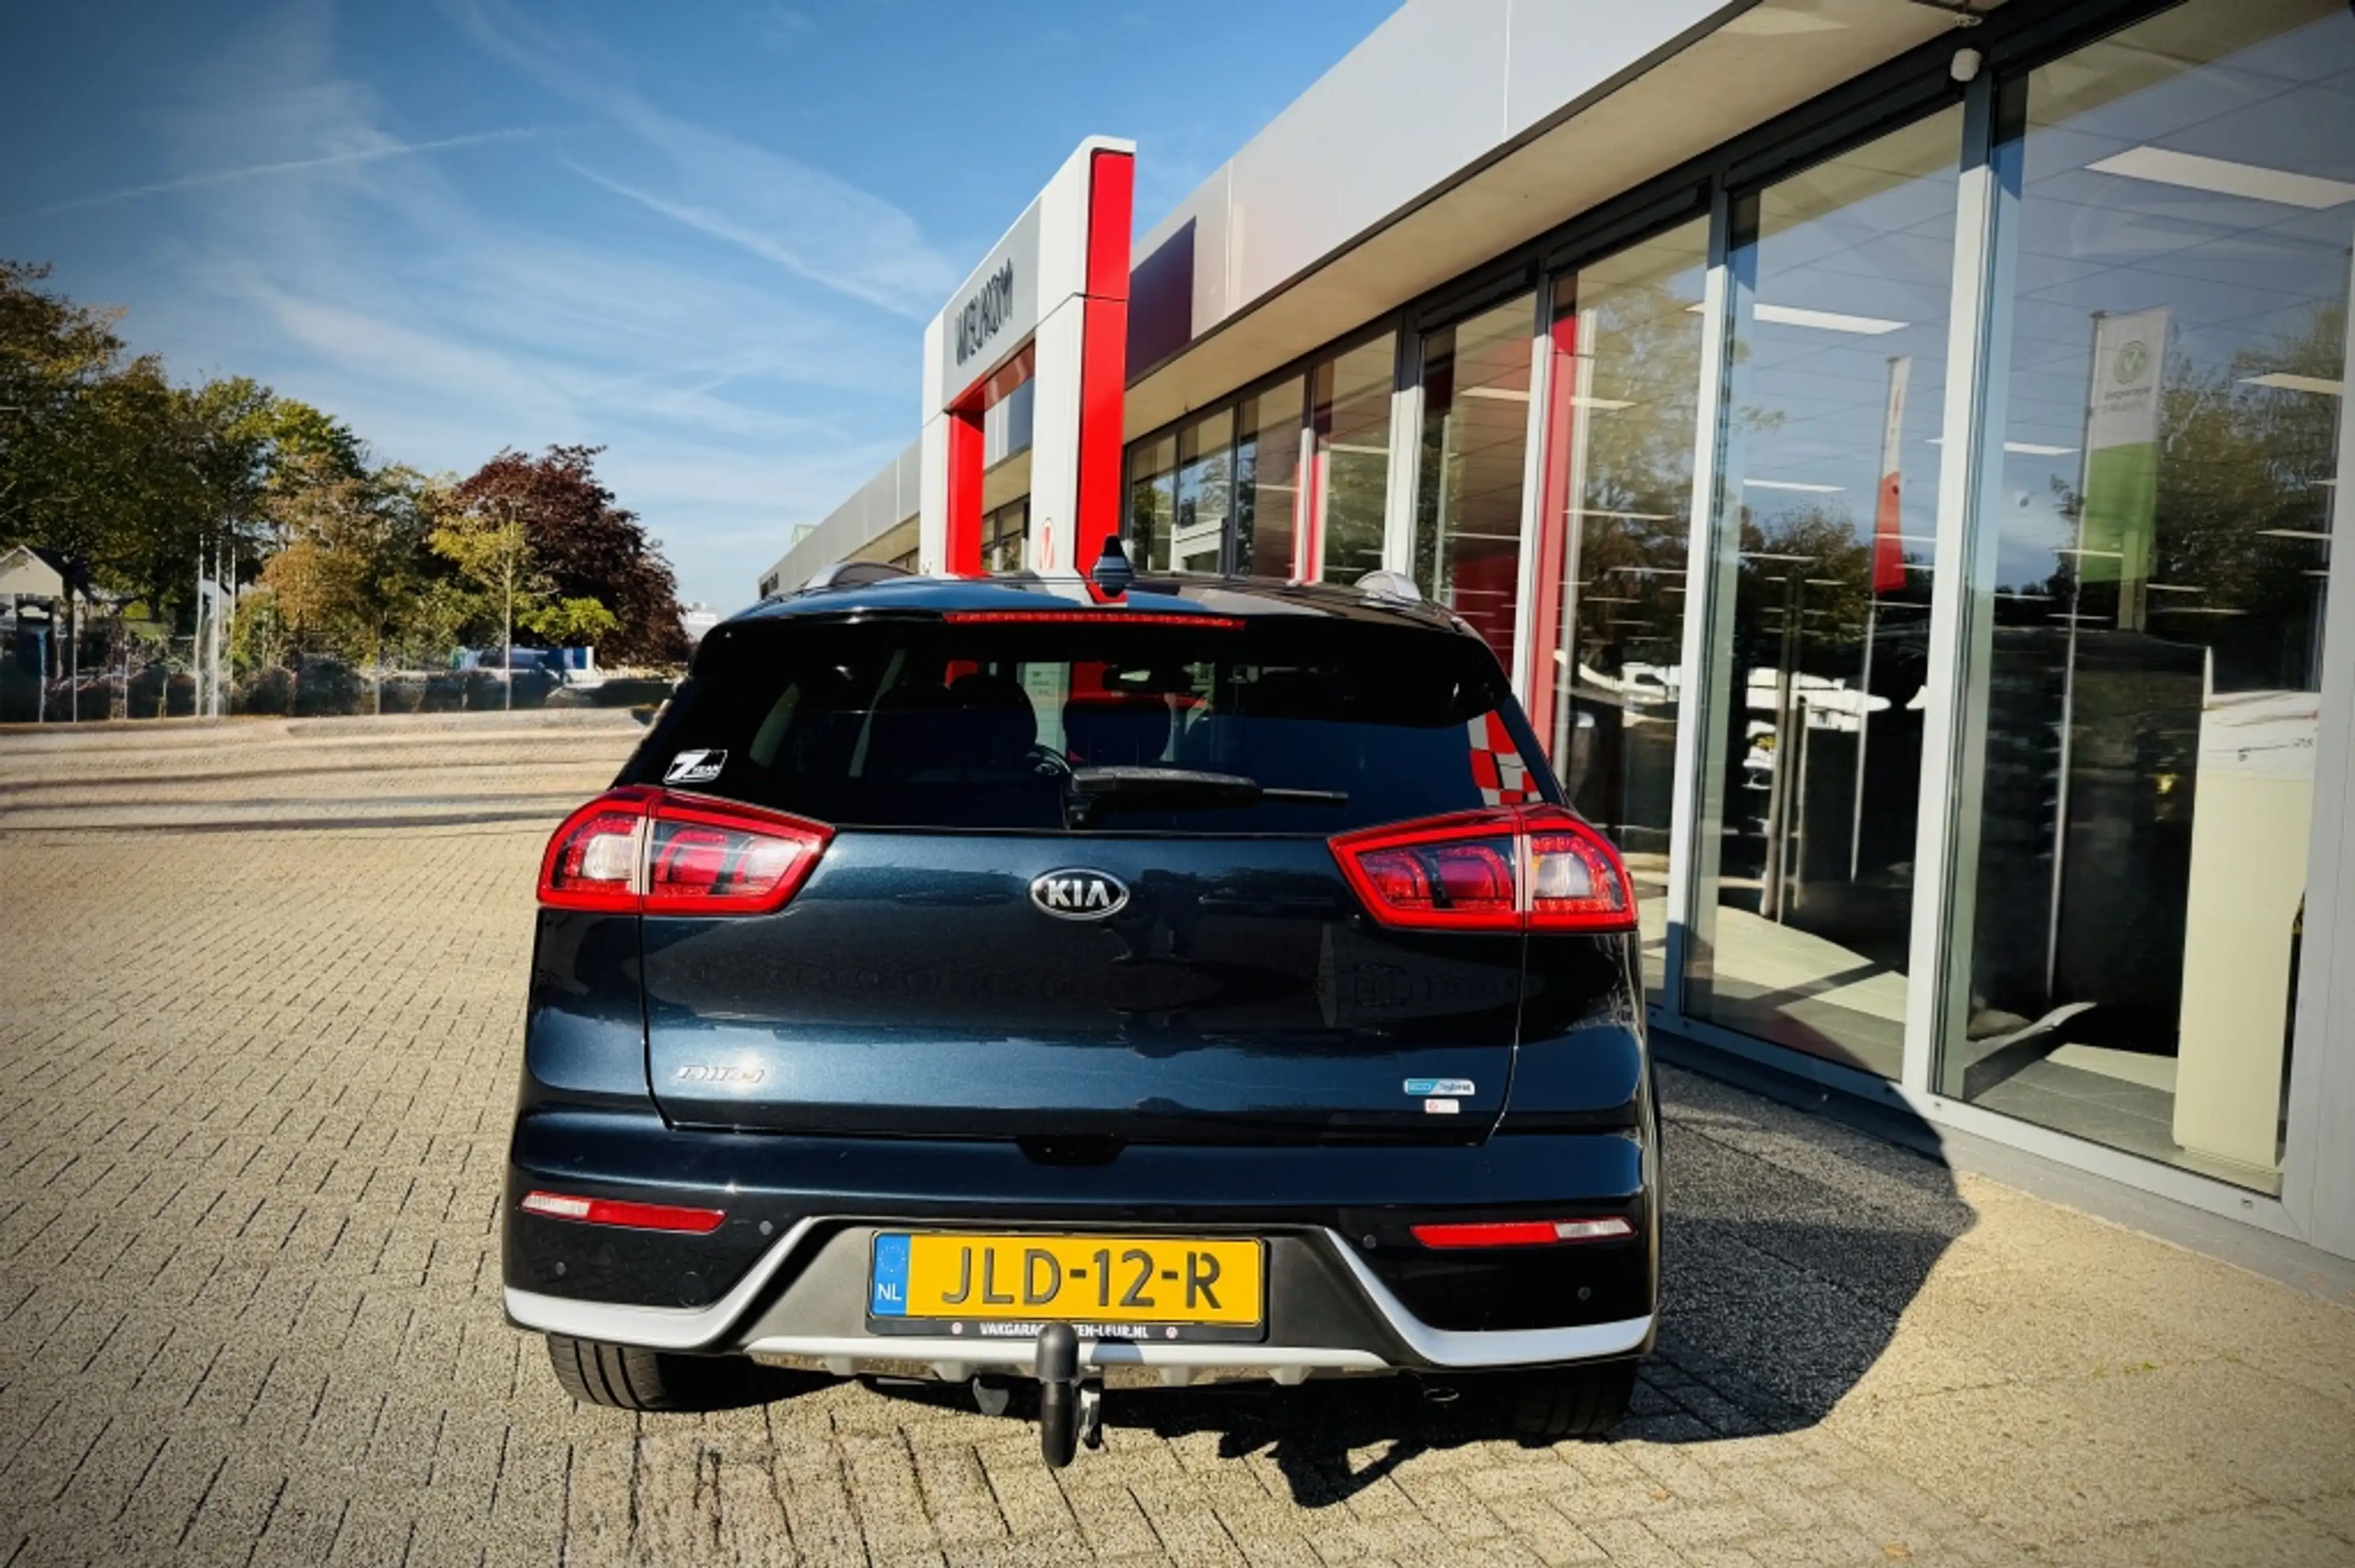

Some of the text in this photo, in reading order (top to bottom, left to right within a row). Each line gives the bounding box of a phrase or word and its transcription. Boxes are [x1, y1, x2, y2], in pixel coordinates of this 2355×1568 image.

[1047, 879, 1109, 908] KIA
[878, 1282, 903, 1301] NL
[941, 1245, 1223, 1310] JLD-12-R
